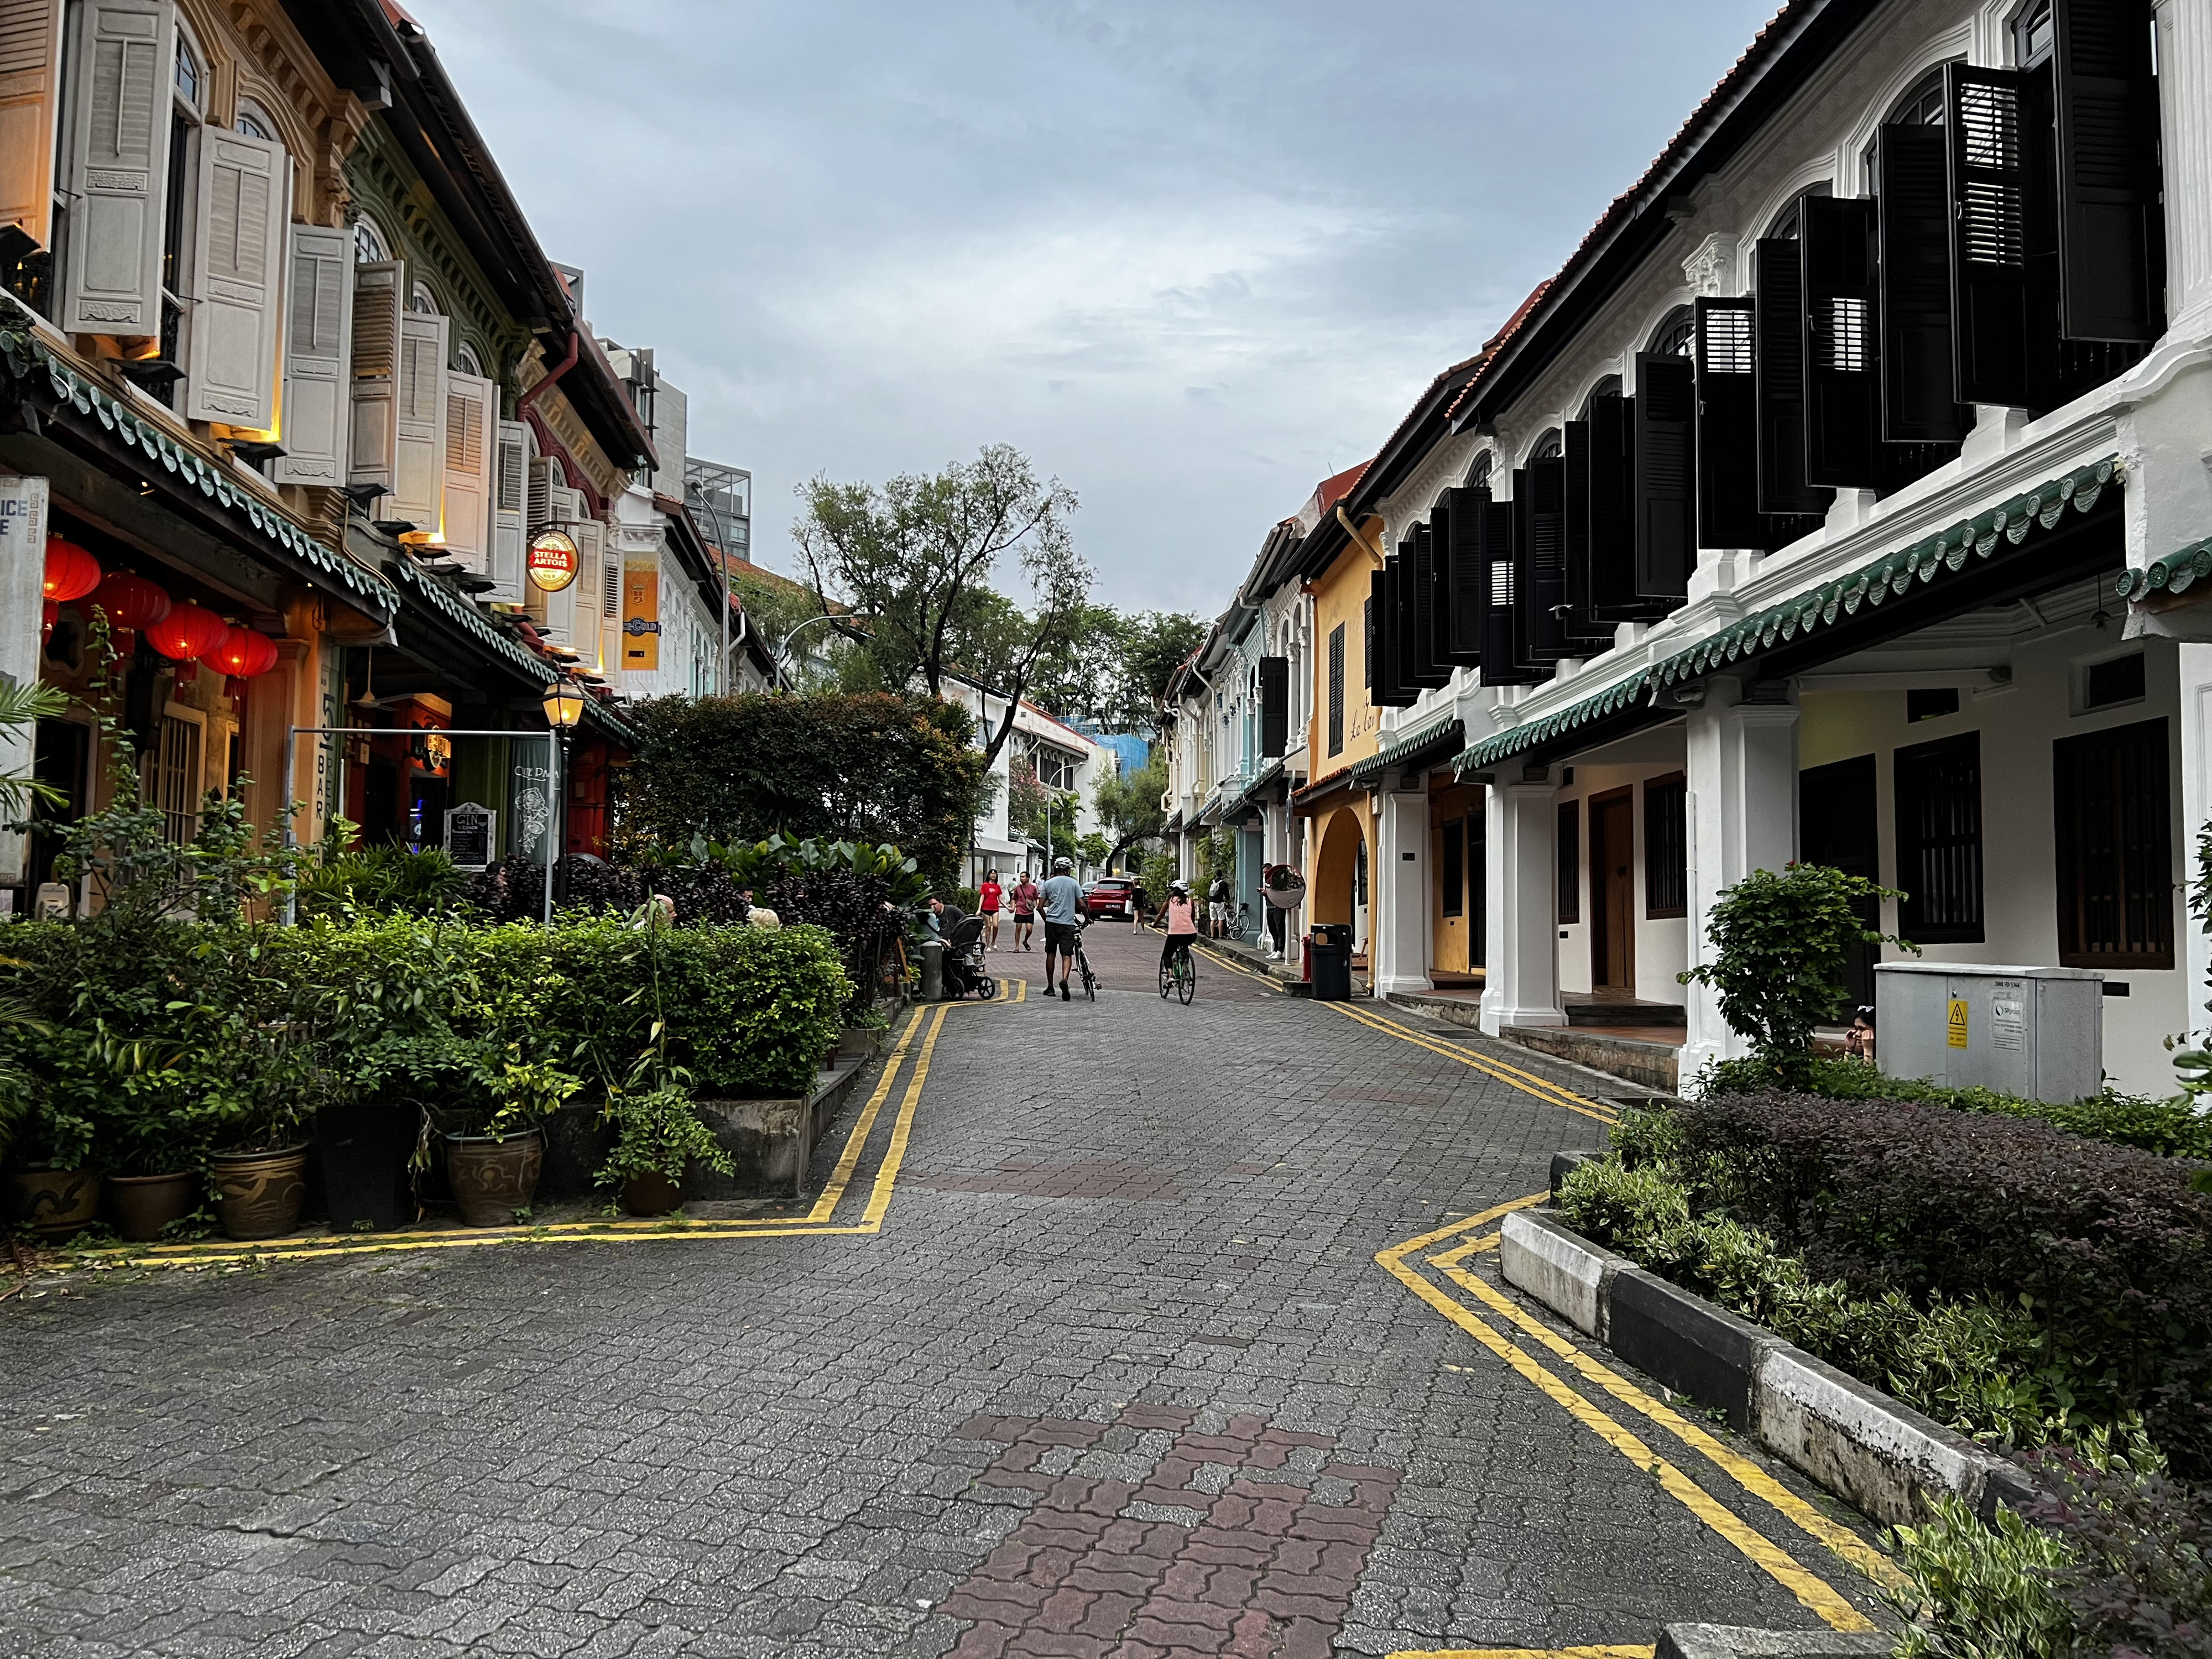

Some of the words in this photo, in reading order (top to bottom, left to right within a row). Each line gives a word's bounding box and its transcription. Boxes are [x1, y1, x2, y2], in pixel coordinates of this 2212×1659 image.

[1, 499, 28, 517] ICE
[534, 551, 567, 560] STELLA
[534, 558, 568, 567] ARTOIS
[457, 814, 478, 825] GIN
